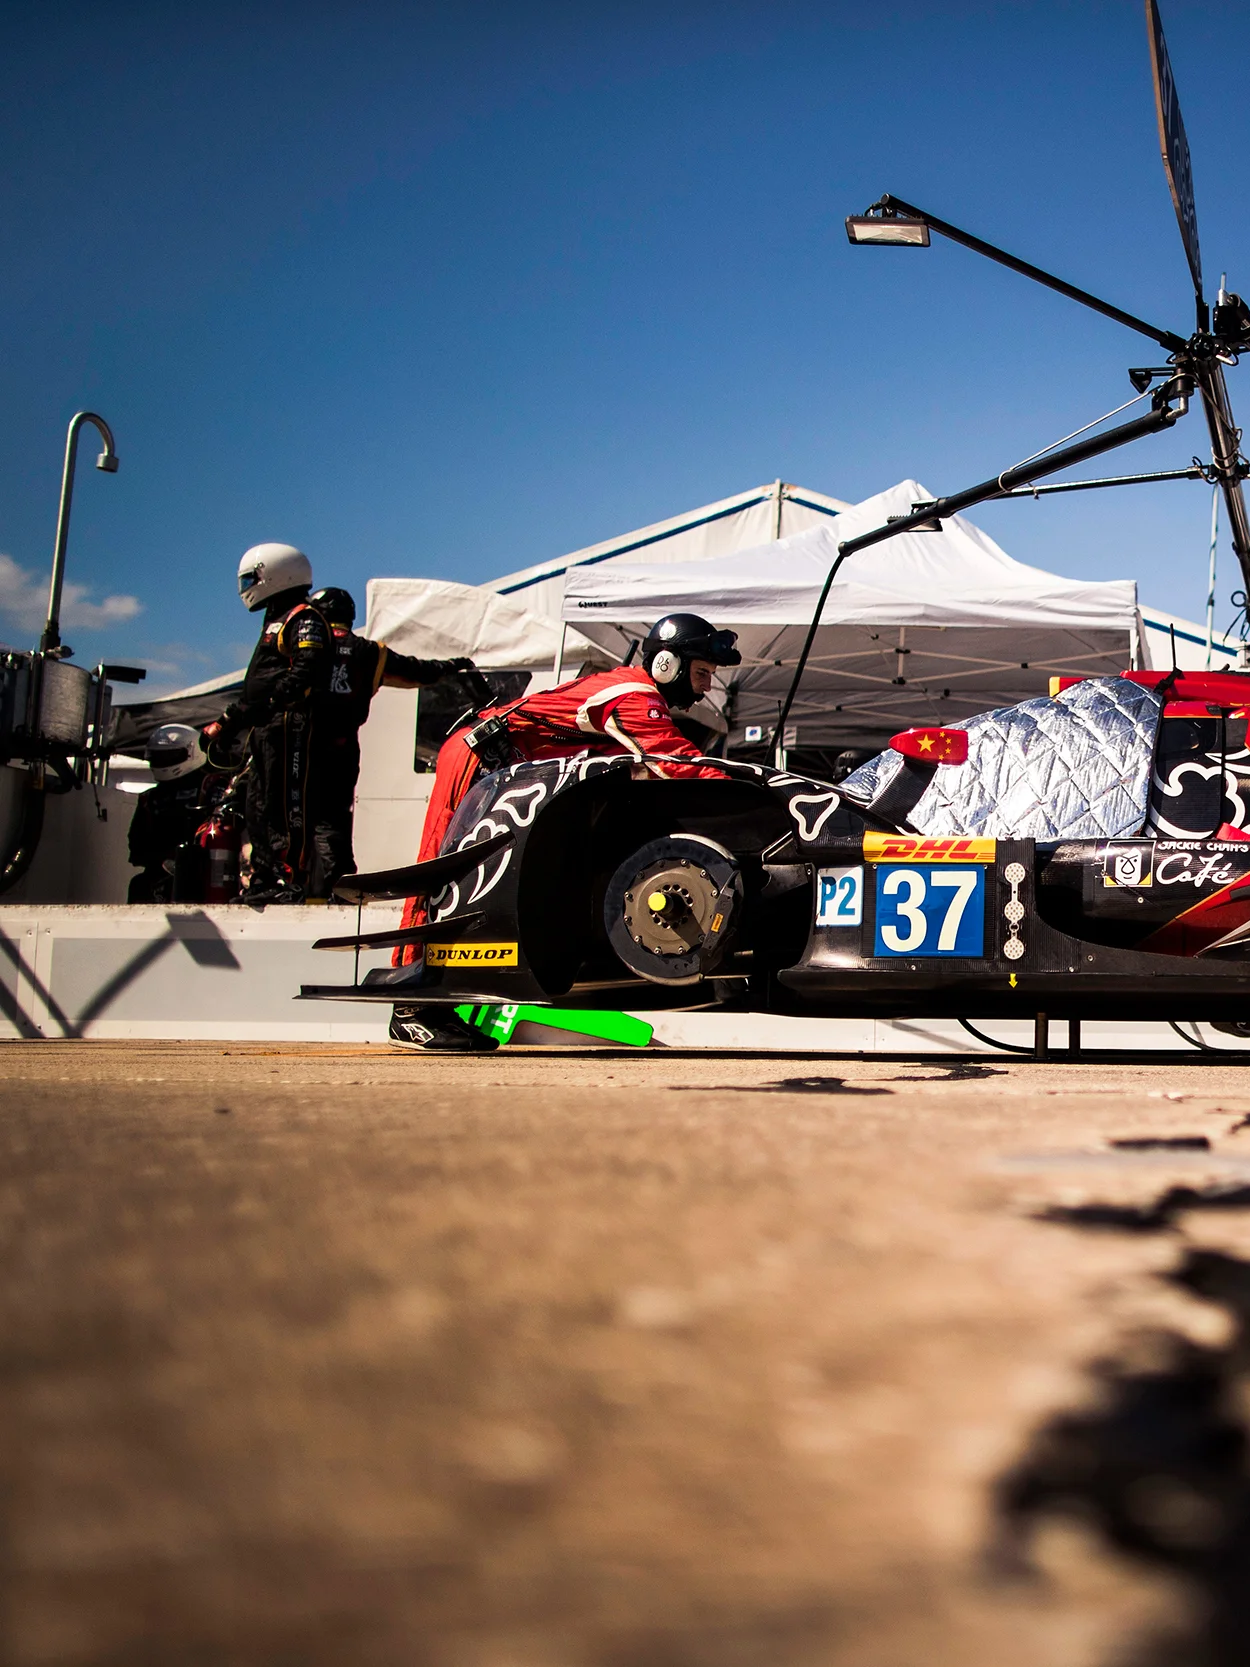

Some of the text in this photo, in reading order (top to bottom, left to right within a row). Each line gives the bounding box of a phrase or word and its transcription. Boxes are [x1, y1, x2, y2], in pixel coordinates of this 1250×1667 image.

[881, 839, 979, 860] DHL
[1157, 841, 1201, 850] JACKIE
[1156, 852, 1235, 888] Café
[820, 876, 857, 916] P2
[880, 869, 978, 952] 37
[436, 949, 513, 960] DUNLOP
